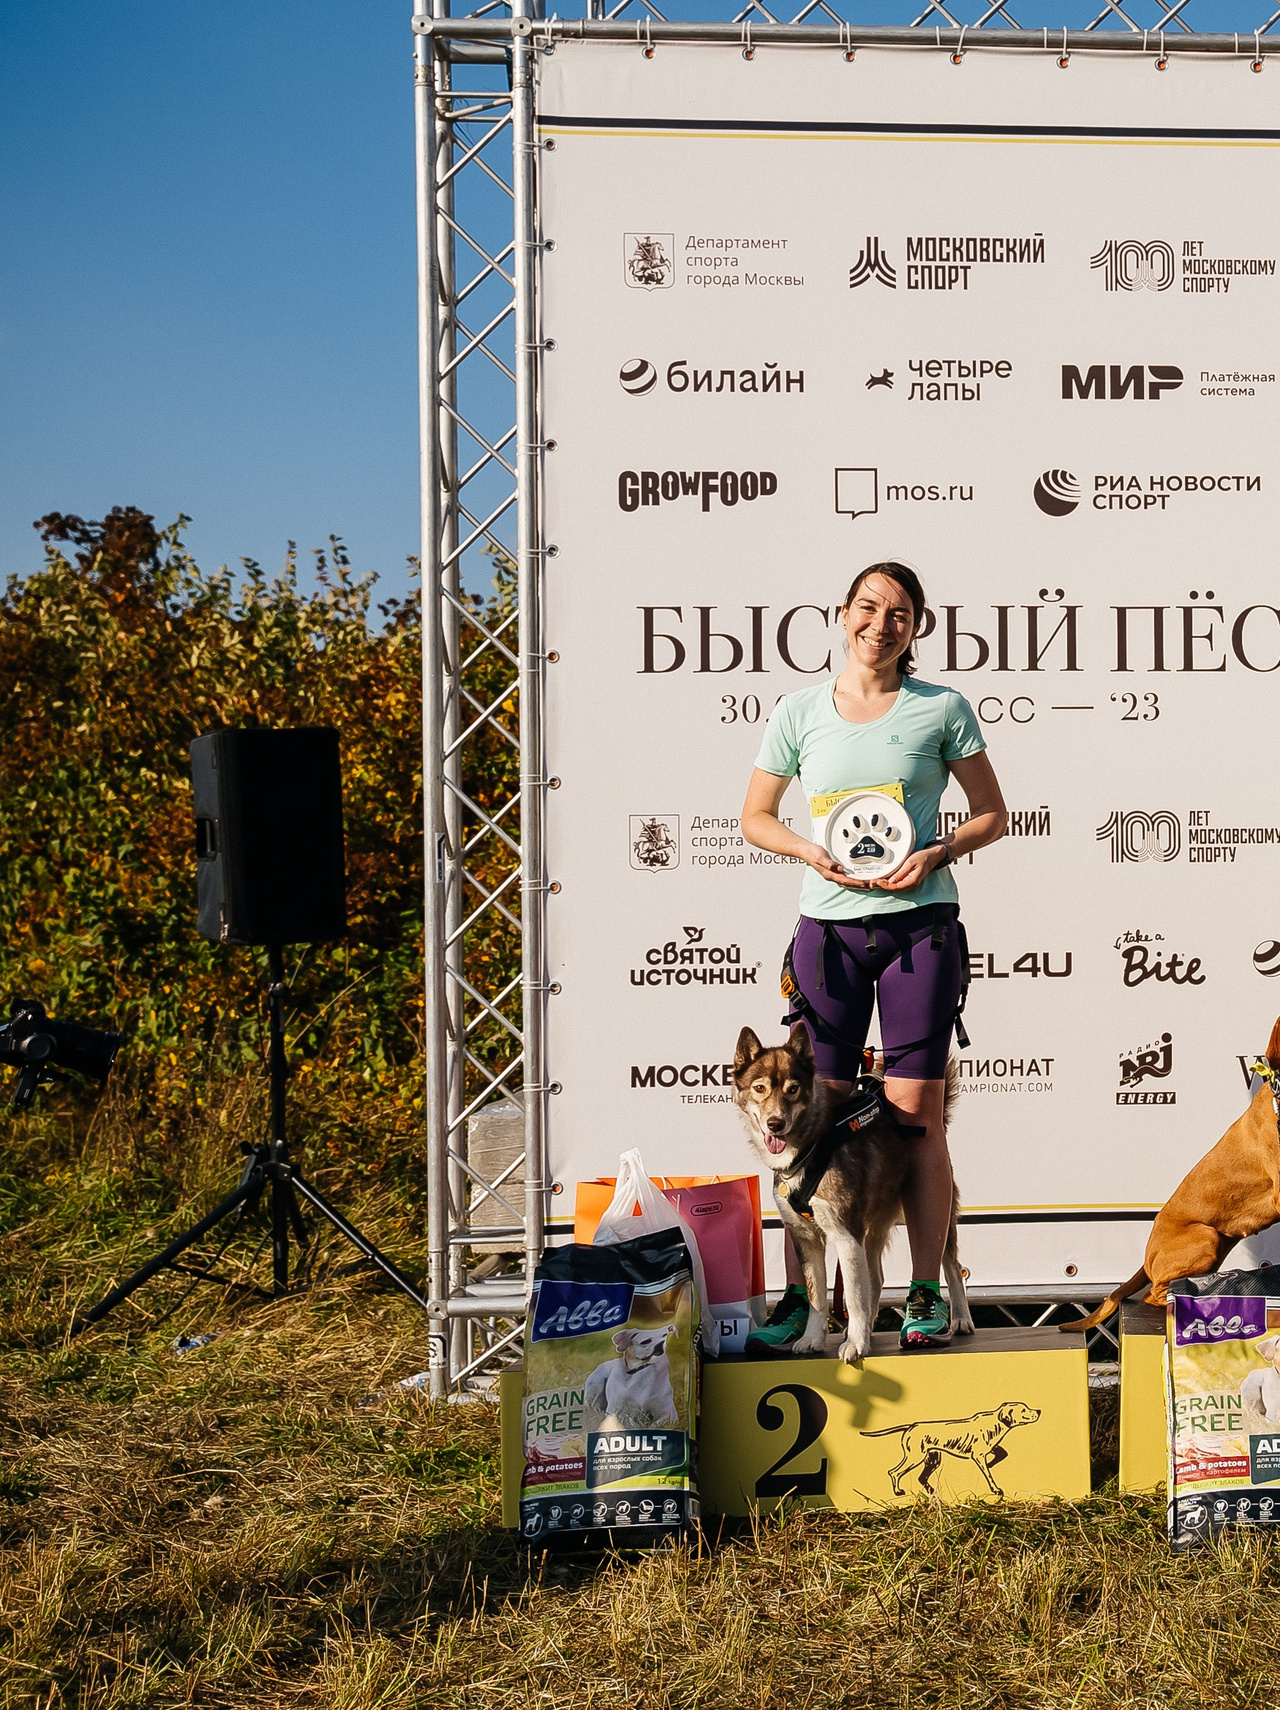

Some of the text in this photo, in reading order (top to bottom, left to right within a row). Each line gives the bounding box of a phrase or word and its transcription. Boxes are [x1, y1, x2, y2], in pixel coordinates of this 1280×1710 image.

[685, 235, 788, 251] Департамент
[907, 232, 1045, 263] МОСКОВСКИЙ
[1182, 241, 1205, 257] ЛЕТ
[686, 256, 738, 270] спорта
[1090, 240, 1175, 292] 100
[1182, 258, 1276, 276] МОСКОВСКОМУ
[686, 272, 804, 288] города Москвы
[907, 265, 972, 291] СПОРТ
[1182, 277, 1231, 294] СПОРТУ
[666, 359, 805, 393] билайн
[908, 359, 1013, 379] четыре
[1200, 371, 1276, 384] Платёжная
[1061, 364, 1184, 401] МИР
[907, 382, 981, 402] лапы
[1200, 387, 1256, 397] система
[618, 470, 778, 513] GROWFOOD
[886, 483, 974, 502] mos.ru
[1094, 475, 1261, 492] РИА НОВОСТИ
[1093, 493, 1171, 510] СПОРТ
[1188, 810, 1211, 827] ЛЕТ
[691, 835, 744, 851] спорта
[1096, 810, 1181, 863] 100
[691, 855, 744, 869] города
[1189, 847, 1237, 863] СПОРТУ
[1123, 929, 1165, 945] take a
[645, 941, 741, 966] святой
[969, 952, 1073, 979] EL4U
[1120, 945, 1206, 987] Bite
[630, 966, 757, 986] источник
[1119, 1040, 1160, 1059] РАДИО
[959, 1058, 1054, 1078] ПИОНАТ
[1116, 1092, 1176, 1105] ENERGY
[526, 1389, 585, 1417] GRAIN
[1176, 1394, 1242, 1415] GRAIN
[525, 1410, 584, 1440] FREE
[1176, 1413, 1243, 1437] FREE
[593, 1435, 667, 1453] ADULT
[754, 1383, 828, 1498] 2
[545, 1462, 583, 1474] potatoes
[593, 1455, 662, 1465] для взрослых собак
[609, 1463, 631, 1471] пород
[1199, 1462, 1207, 1470] &
[1208, 1460, 1247, 1470] potatoes
[657, 1477, 667, 1485] 12
